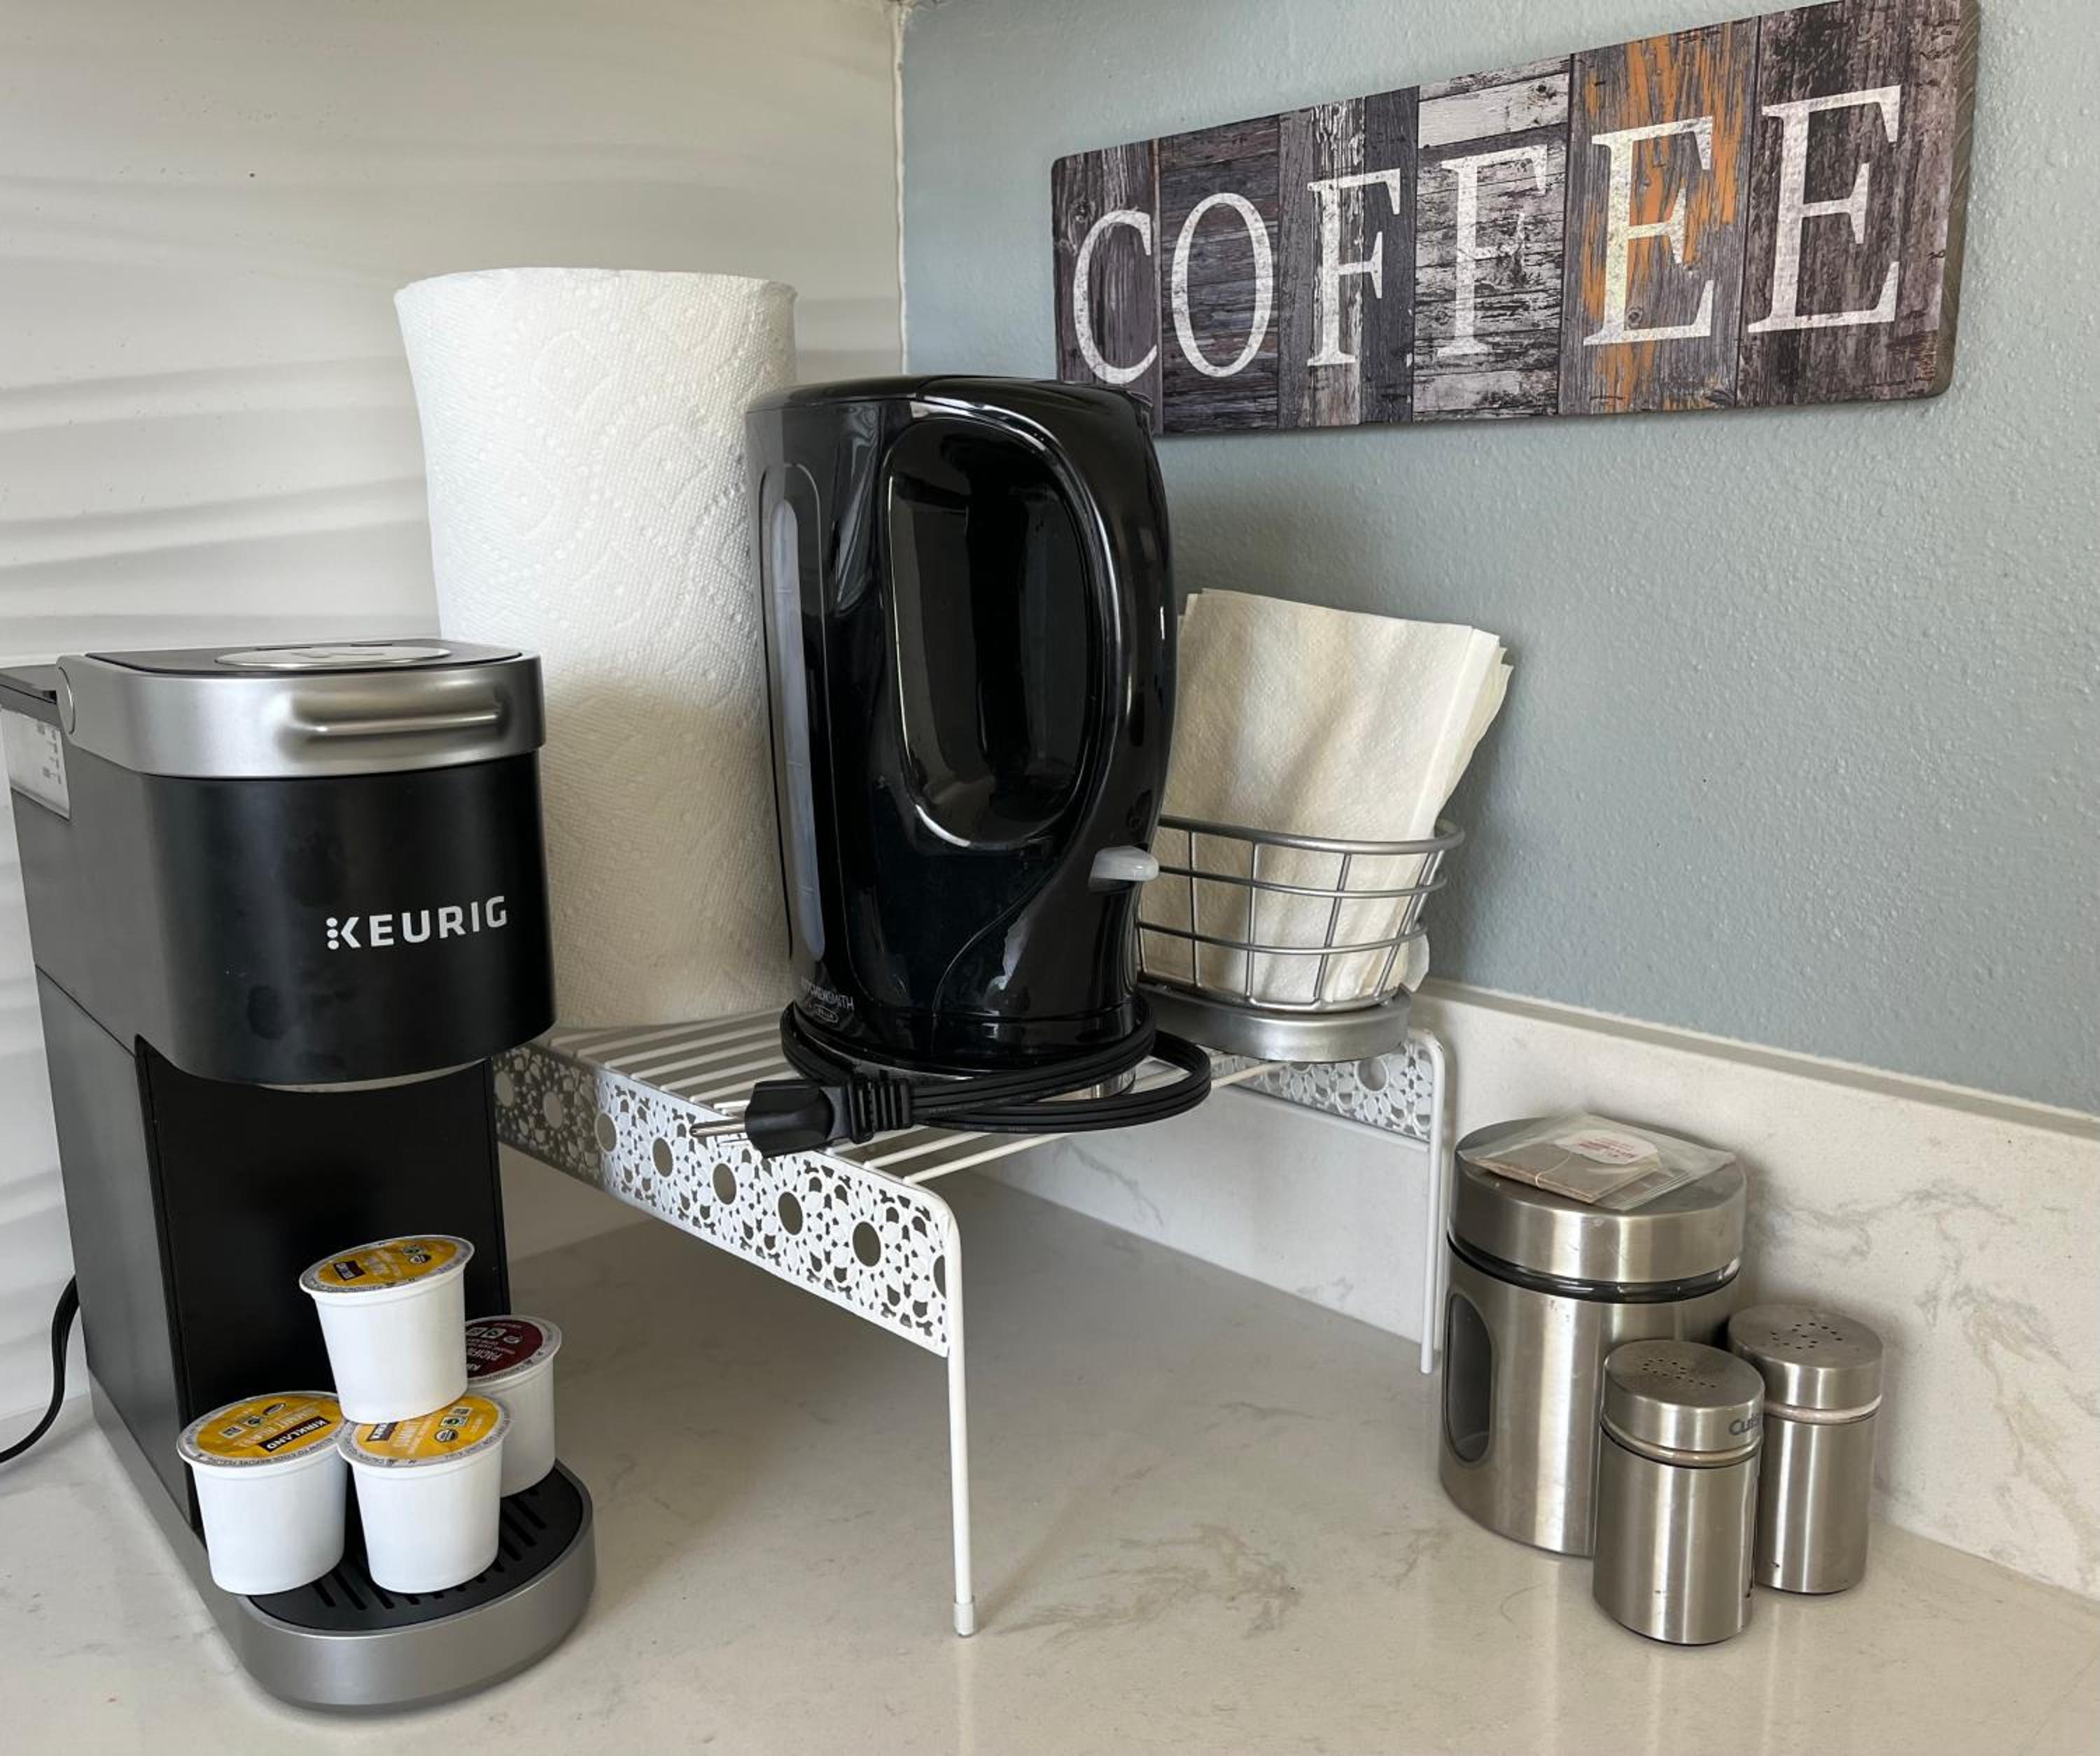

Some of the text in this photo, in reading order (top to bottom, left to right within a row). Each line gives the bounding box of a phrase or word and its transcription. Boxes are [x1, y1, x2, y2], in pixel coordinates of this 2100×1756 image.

[1073, 83, 1903, 384] COFFEE
[326, 896, 507, 950] KEURIG
[267, 1419, 328, 1449] KIRKLAND
